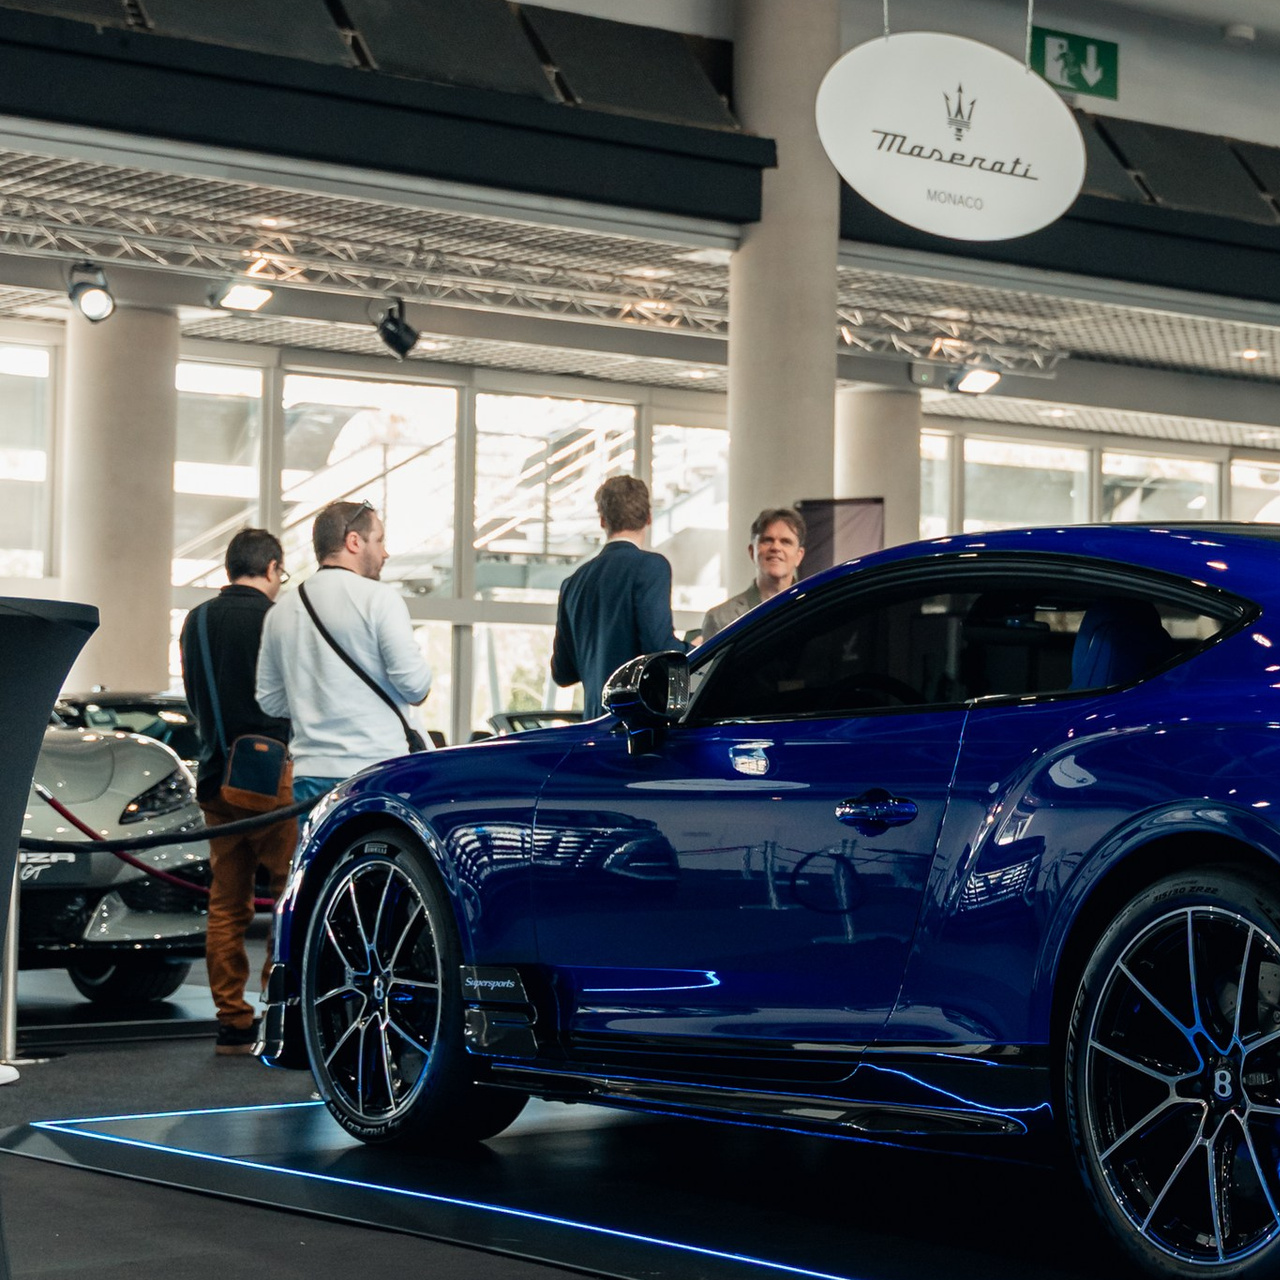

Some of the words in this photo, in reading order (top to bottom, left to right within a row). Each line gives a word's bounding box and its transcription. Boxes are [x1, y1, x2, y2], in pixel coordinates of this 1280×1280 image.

[871, 130, 1039, 181] Maserati
[926, 188, 984, 211] MONACO
[464, 976, 516, 991] Supersports
[1213, 1070, 1233, 1098] B
